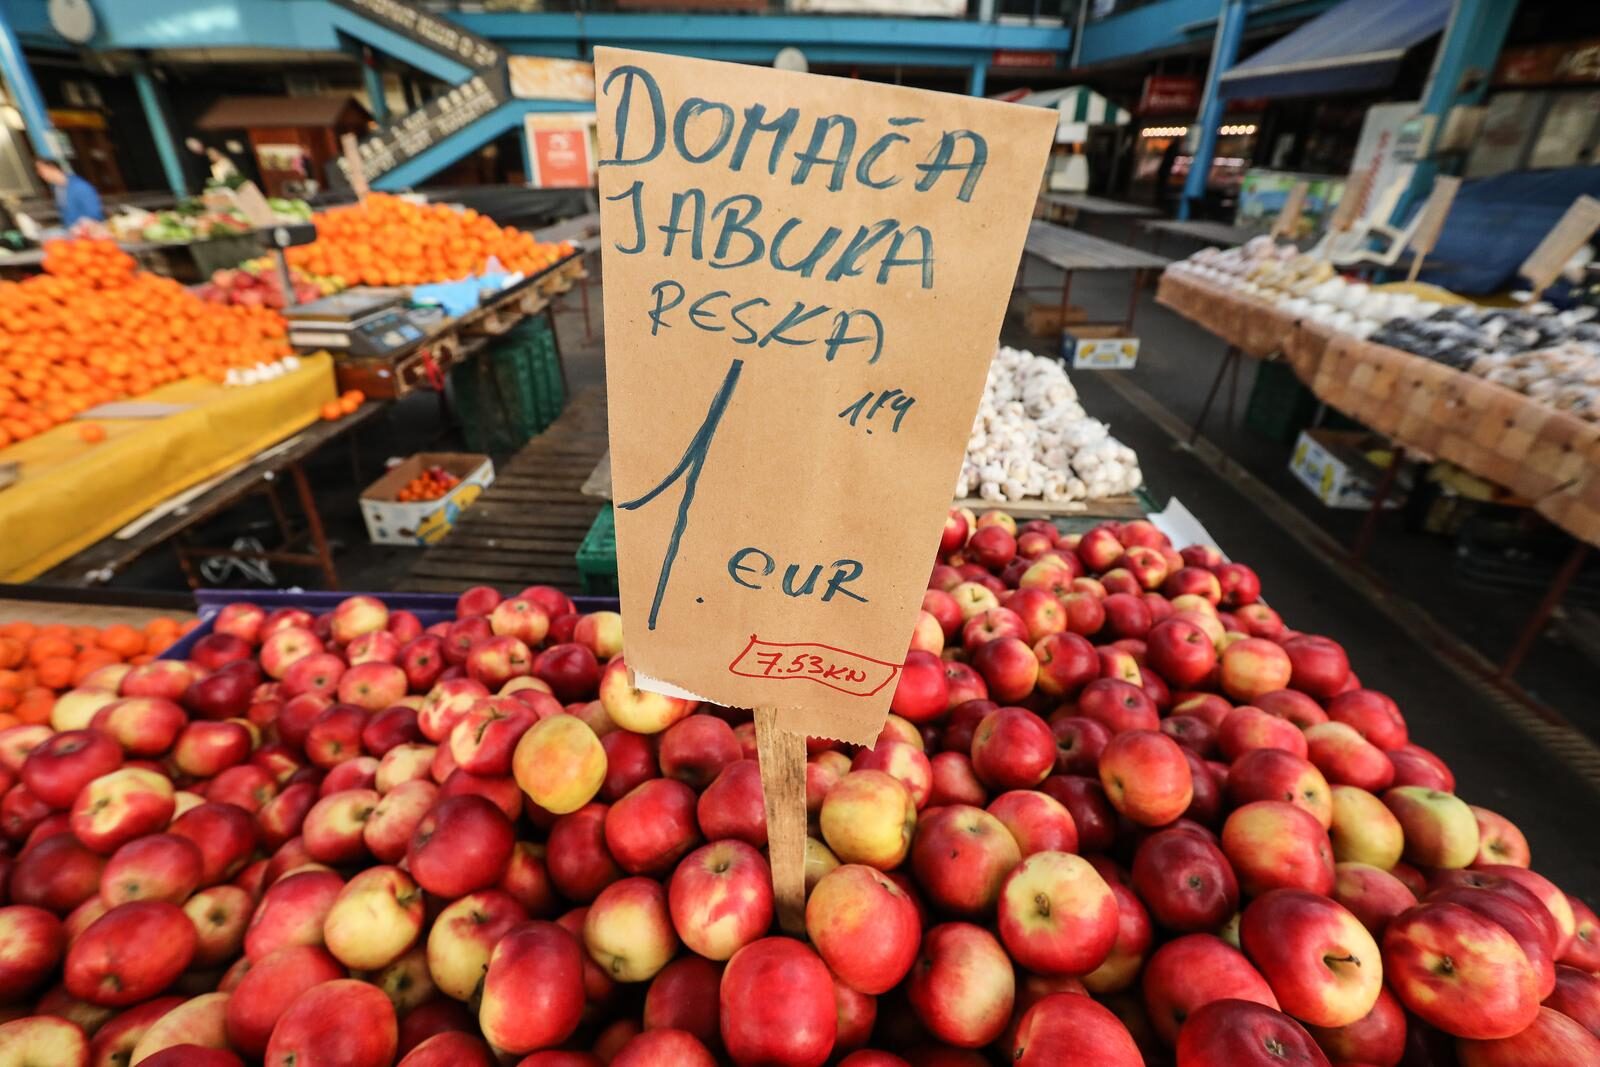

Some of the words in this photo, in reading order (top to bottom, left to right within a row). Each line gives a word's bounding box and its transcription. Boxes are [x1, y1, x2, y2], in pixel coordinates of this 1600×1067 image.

[598, 65, 988, 202] DOMAČA
[606, 181, 934, 289] JABUKA
[648, 280, 884, 365] RESKA
